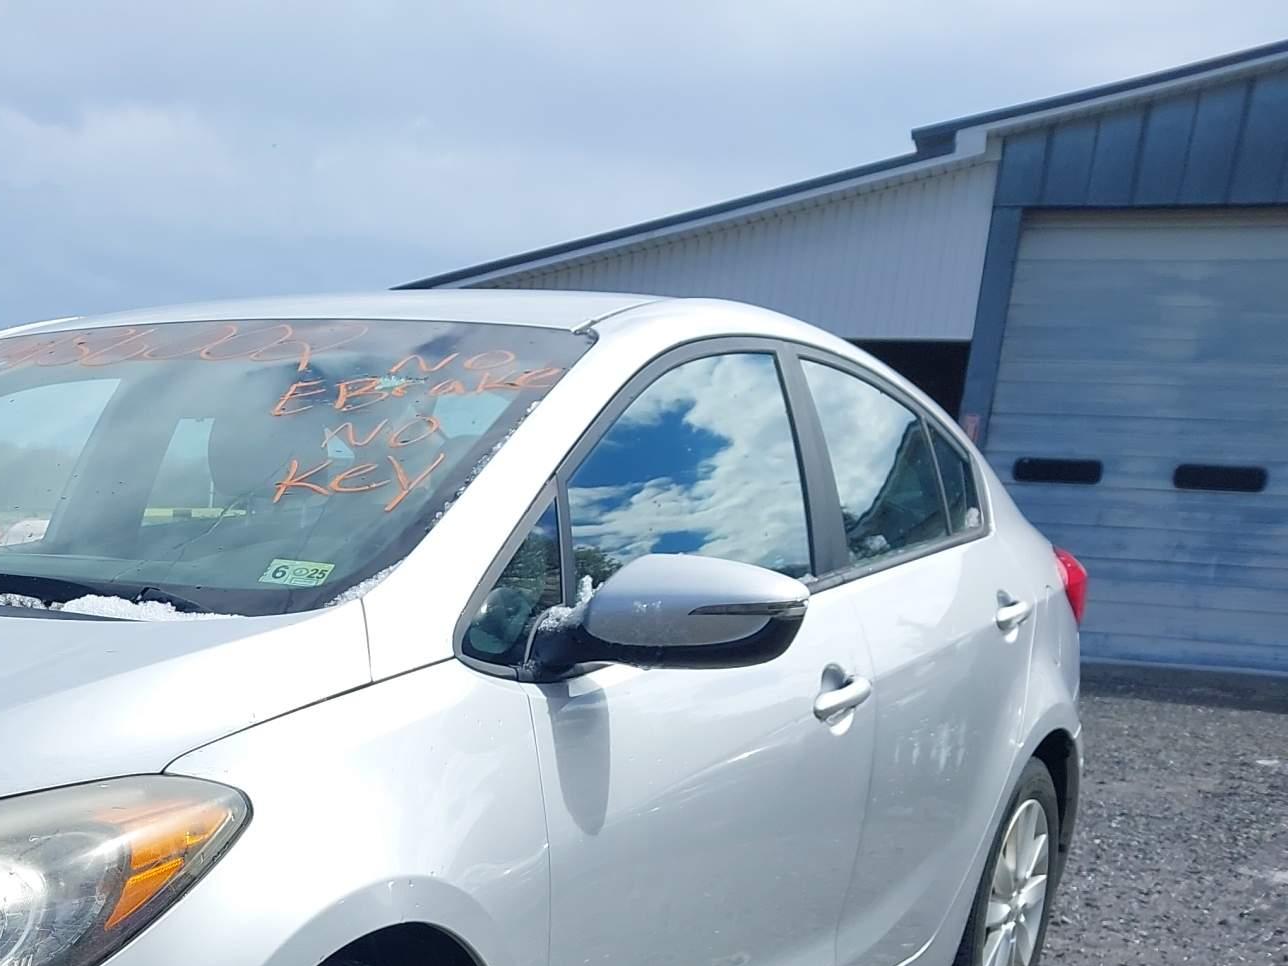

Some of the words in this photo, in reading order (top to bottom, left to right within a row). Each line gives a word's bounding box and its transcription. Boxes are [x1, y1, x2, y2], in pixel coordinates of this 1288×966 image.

[389, 349, 515, 374] NO
[320, 414, 440, 448] NO
[271, 565, 289, 579] 6
[306, 568, 328, 579] 25
